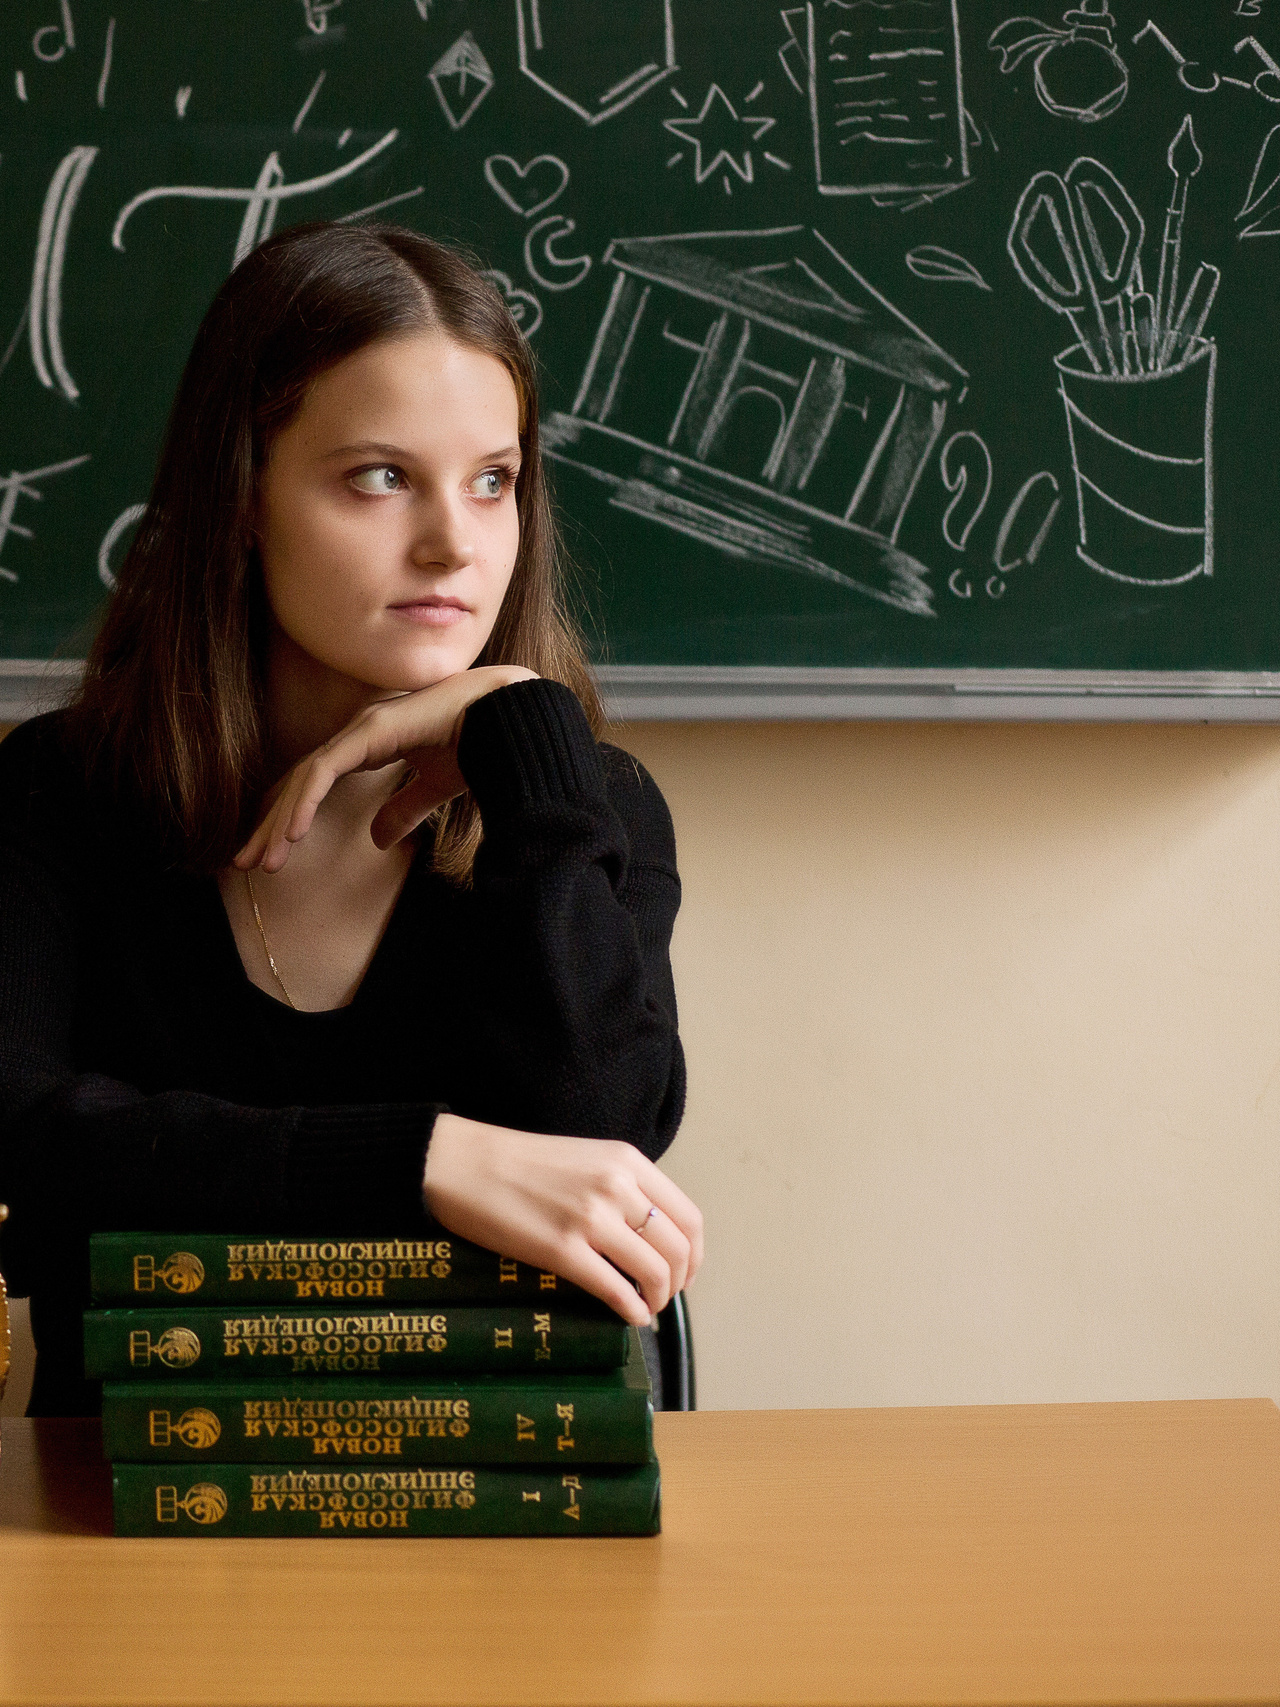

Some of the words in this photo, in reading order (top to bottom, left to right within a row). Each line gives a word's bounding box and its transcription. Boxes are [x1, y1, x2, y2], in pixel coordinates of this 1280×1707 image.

[227, 1239, 452, 1261] ЭНЦИКЛОПЕДИЯ
[227, 1261, 452, 1281] ФИЛОСОФСКАЯ
[295, 1280, 385, 1298] НОВАЯ
[223, 1313, 448, 1337] ЭНЦИКЛОПЕДИЯ
[223, 1335, 448, 1356] ФИЛОСОФСКАЯ
[291, 1355, 381, 1373] НОВАЯ
[243, 1396, 471, 1419] ЭНЦИКЛОПЕДИЯ
[243, 1418, 471, 1438] ФИЛОСОФСКАЯ
[516, 1413, 536, 1441] IV
[313, 1437, 402, 1455] НОВАЯ
[250, 1468, 476, 1492] ЭНЦИКЛОПЕДИЯ
[251, 1490, 476, 1513] ФИЛОСОФСКАЯ
[320, 1510, 409, 1529] НОВАЯ
